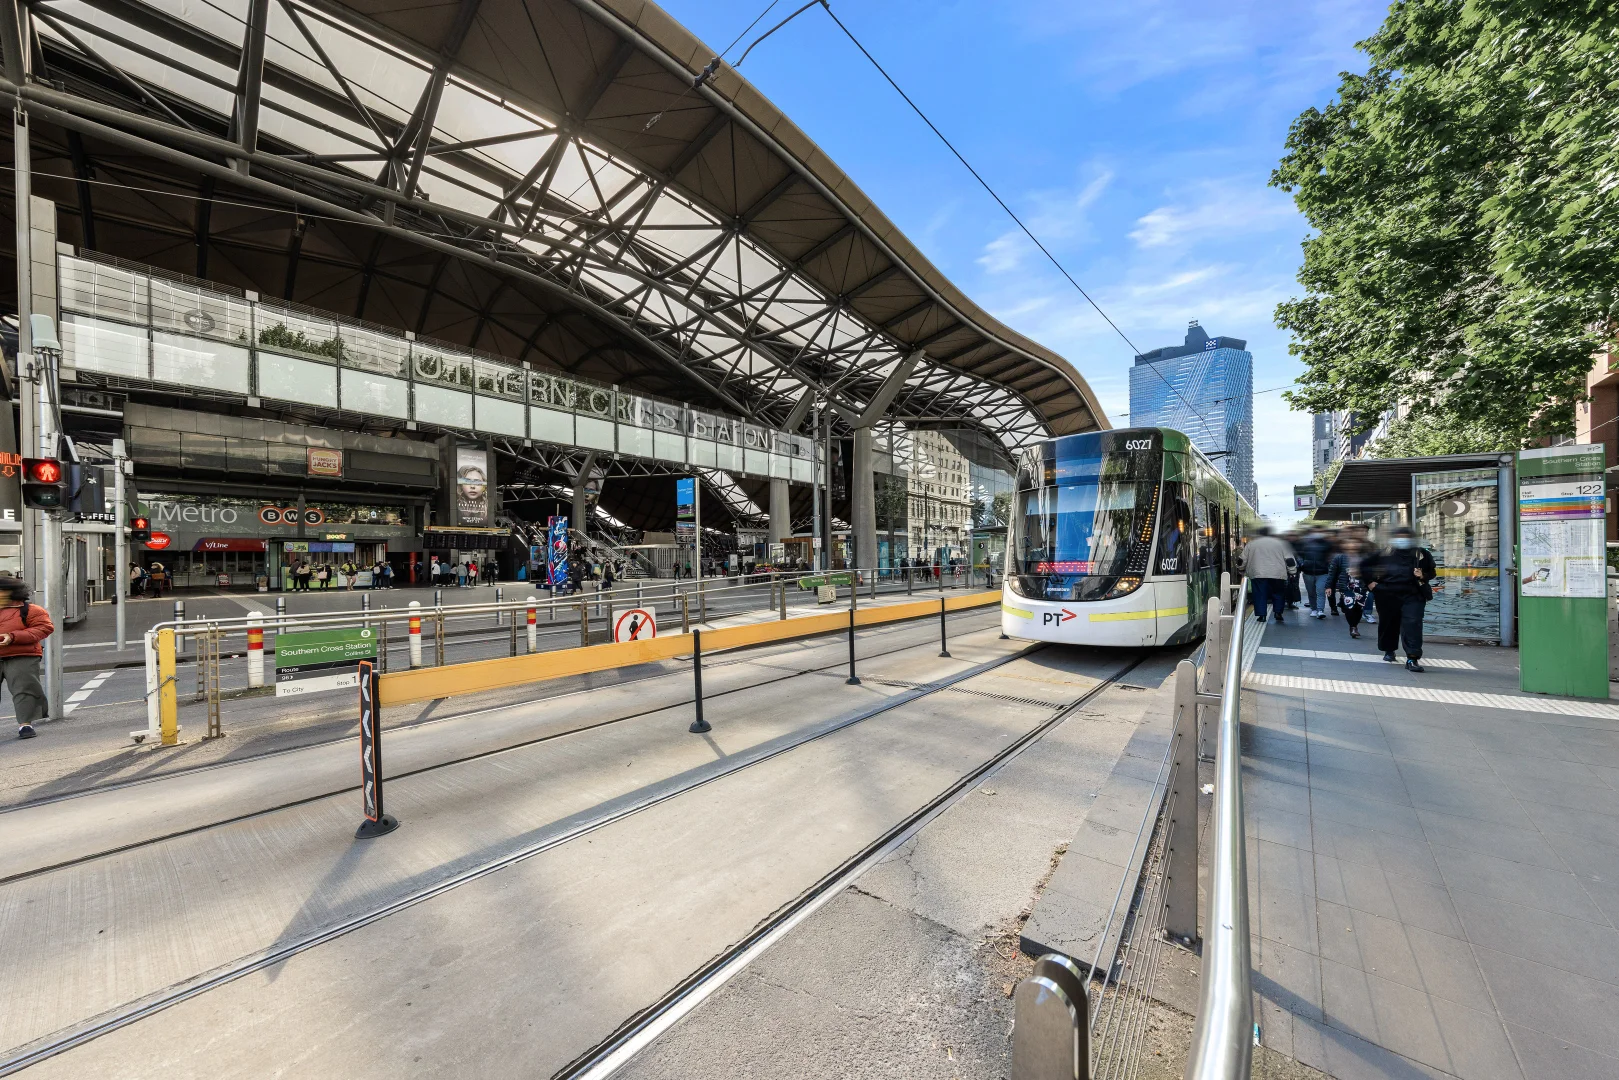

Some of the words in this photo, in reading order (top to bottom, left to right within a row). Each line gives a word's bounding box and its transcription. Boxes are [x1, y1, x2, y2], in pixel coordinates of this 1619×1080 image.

[1125, 439, 1152, 450] 6027
[312, 461, 338, 469] JACK'S
[1576, 484, 1602, 495] 122
[80, 512, 115, 521] CFFEE
[157, 503, 238, 524] Metro
[205, 541, 229, 549] V/Line
[1161, 557, 1178, 571] 6027
[280, 647, 320, 657] Southern
[320, 645, 344, 653] Cross
[345, 642, 372, 650] Station
